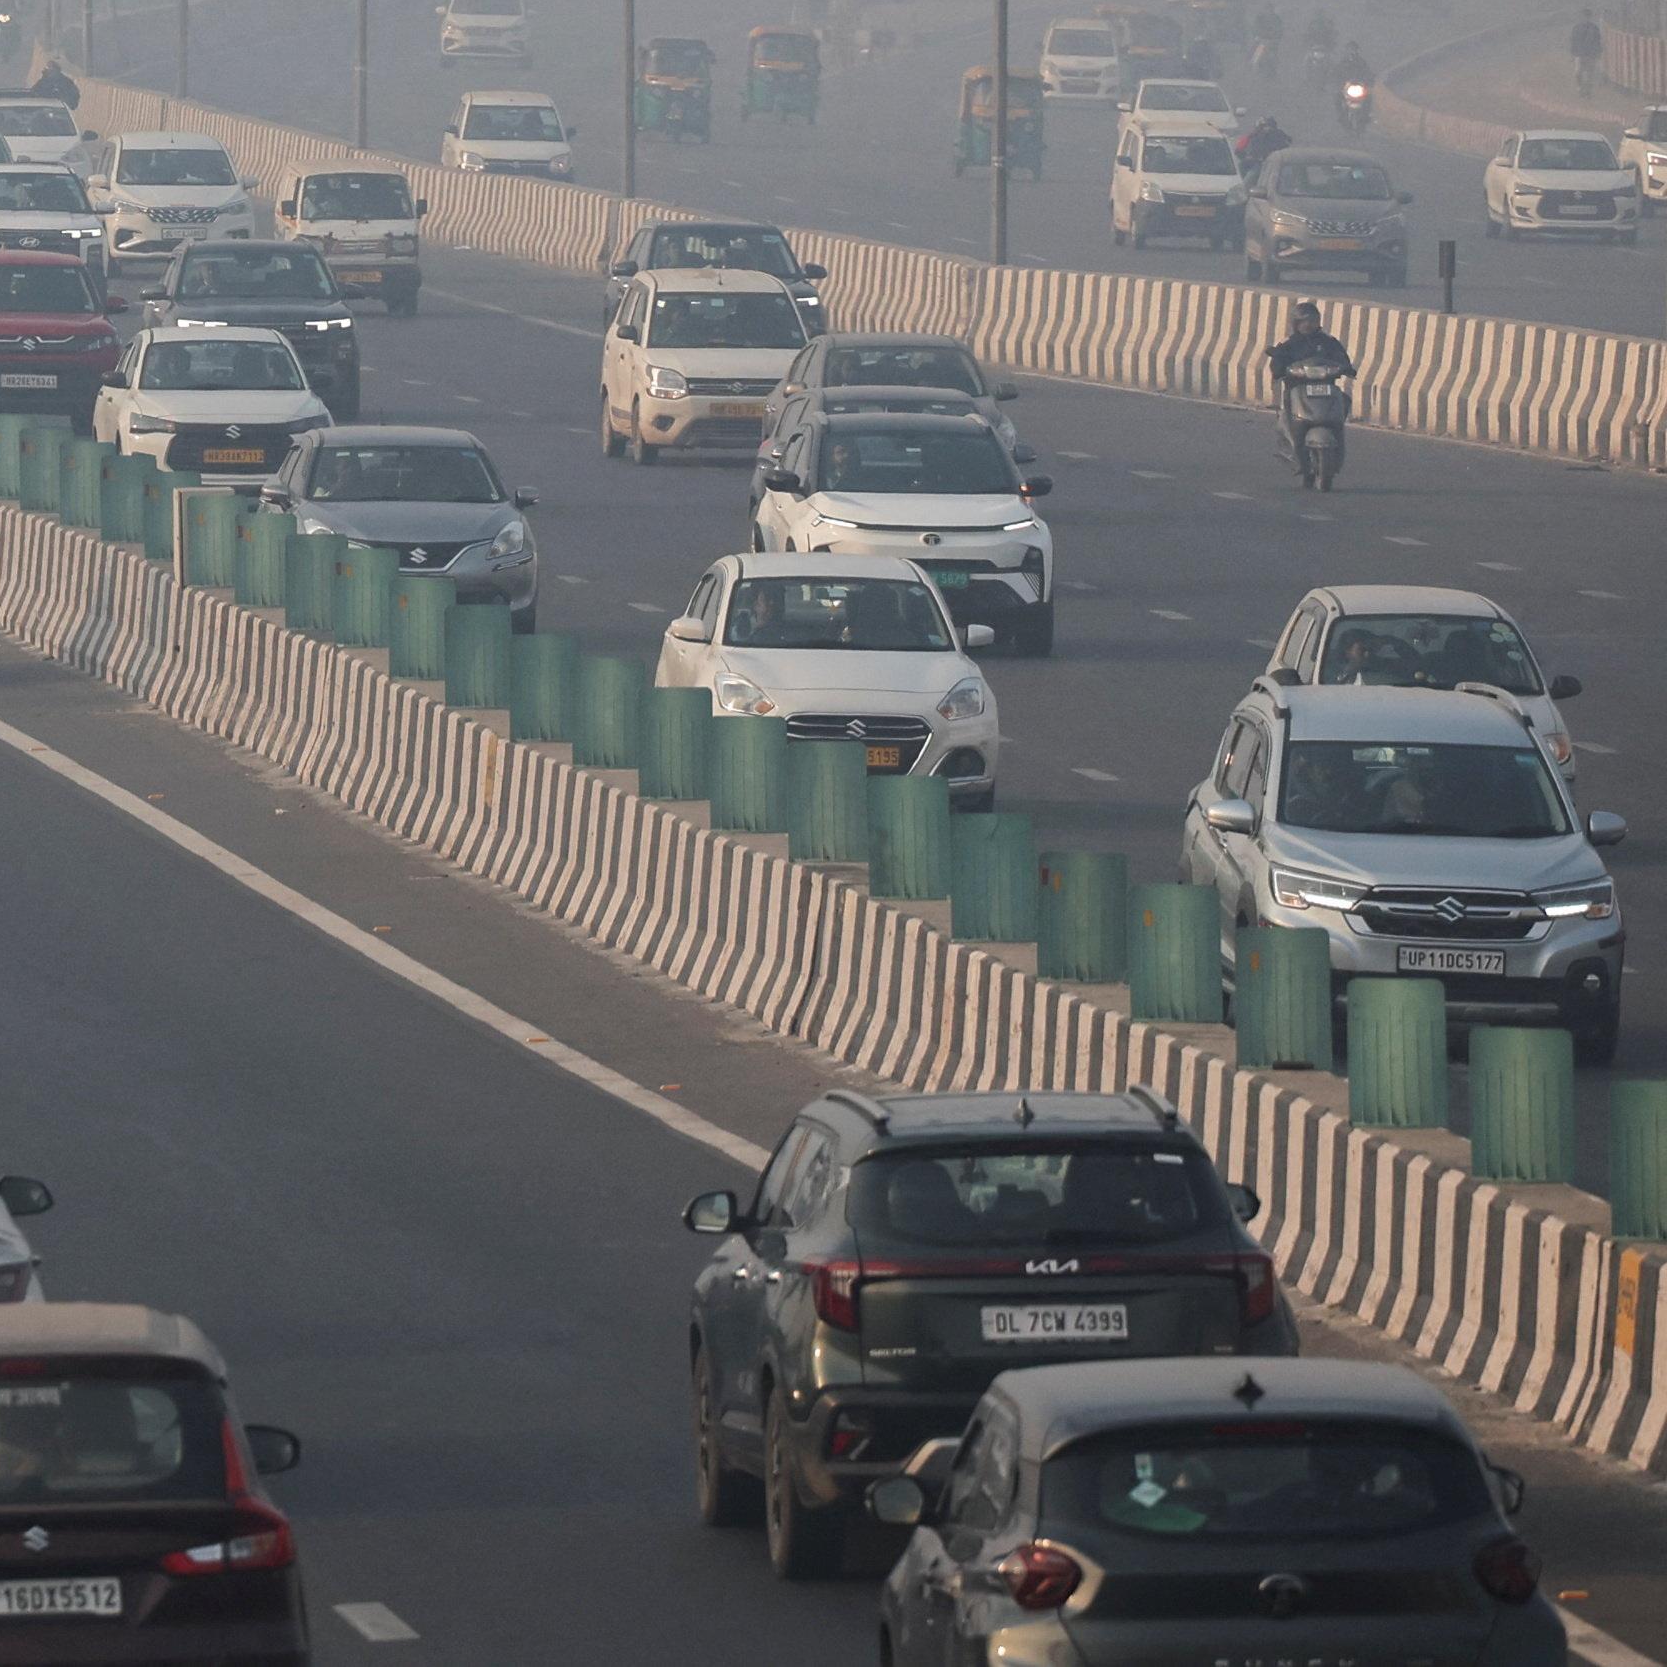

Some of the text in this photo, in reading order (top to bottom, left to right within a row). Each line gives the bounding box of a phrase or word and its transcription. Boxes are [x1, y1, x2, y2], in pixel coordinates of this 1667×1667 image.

[1408, 951, 1503, 971] UP11DC5177
[1025, 1258, 1079, 1273] KIA
[1028, 1310, 1067, 1331] 7CW
[1074, 1310, 1124, 1331] 4399
